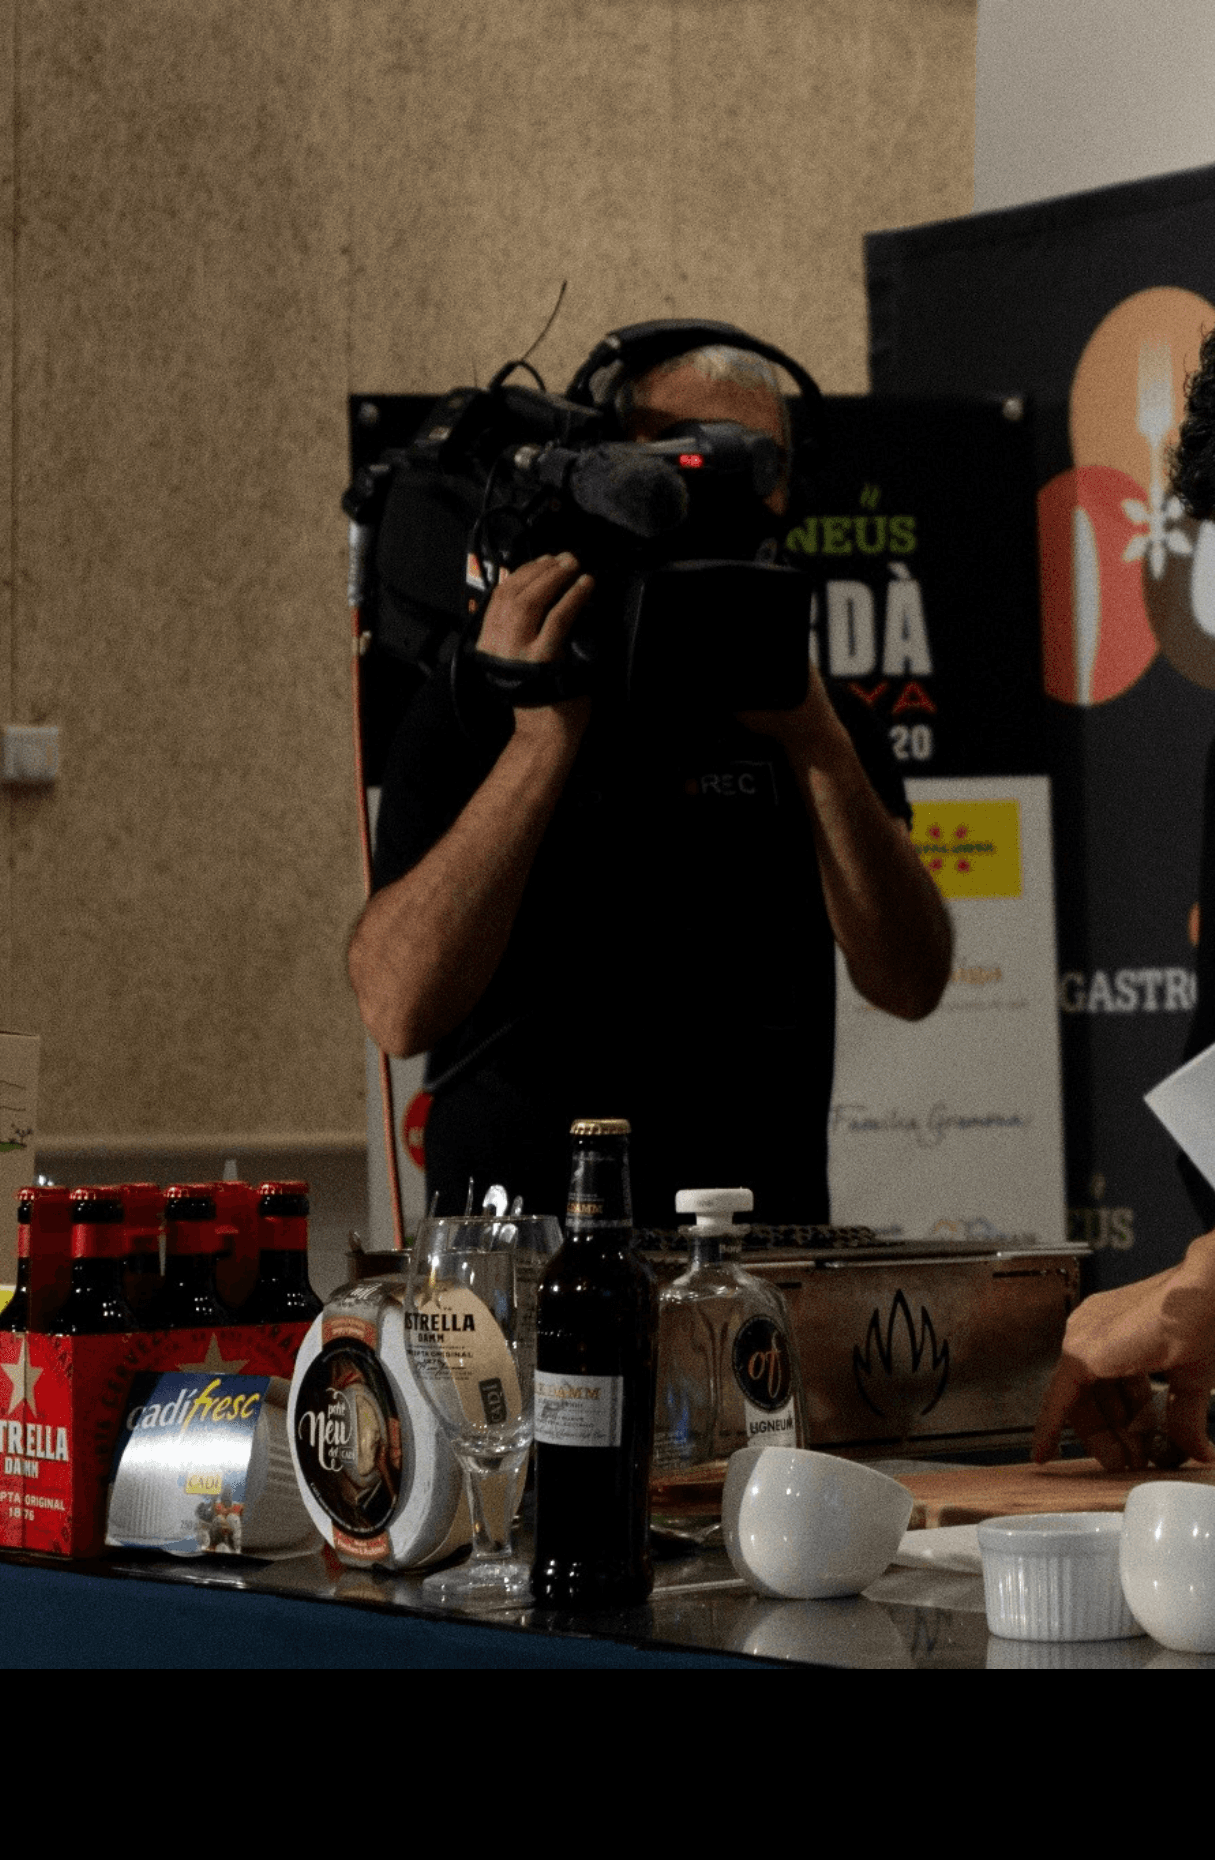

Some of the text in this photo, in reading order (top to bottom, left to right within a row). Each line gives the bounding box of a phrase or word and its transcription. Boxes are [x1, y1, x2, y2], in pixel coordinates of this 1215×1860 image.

[808, 561, 934, 678] DÀ
[700, 773, 757, 796] REC
[4, 1457, 39, 1479] DAMM
[24, 1494, 65, 1511] ORIGINAL
[9, 1507, 35, 1521] 1876
